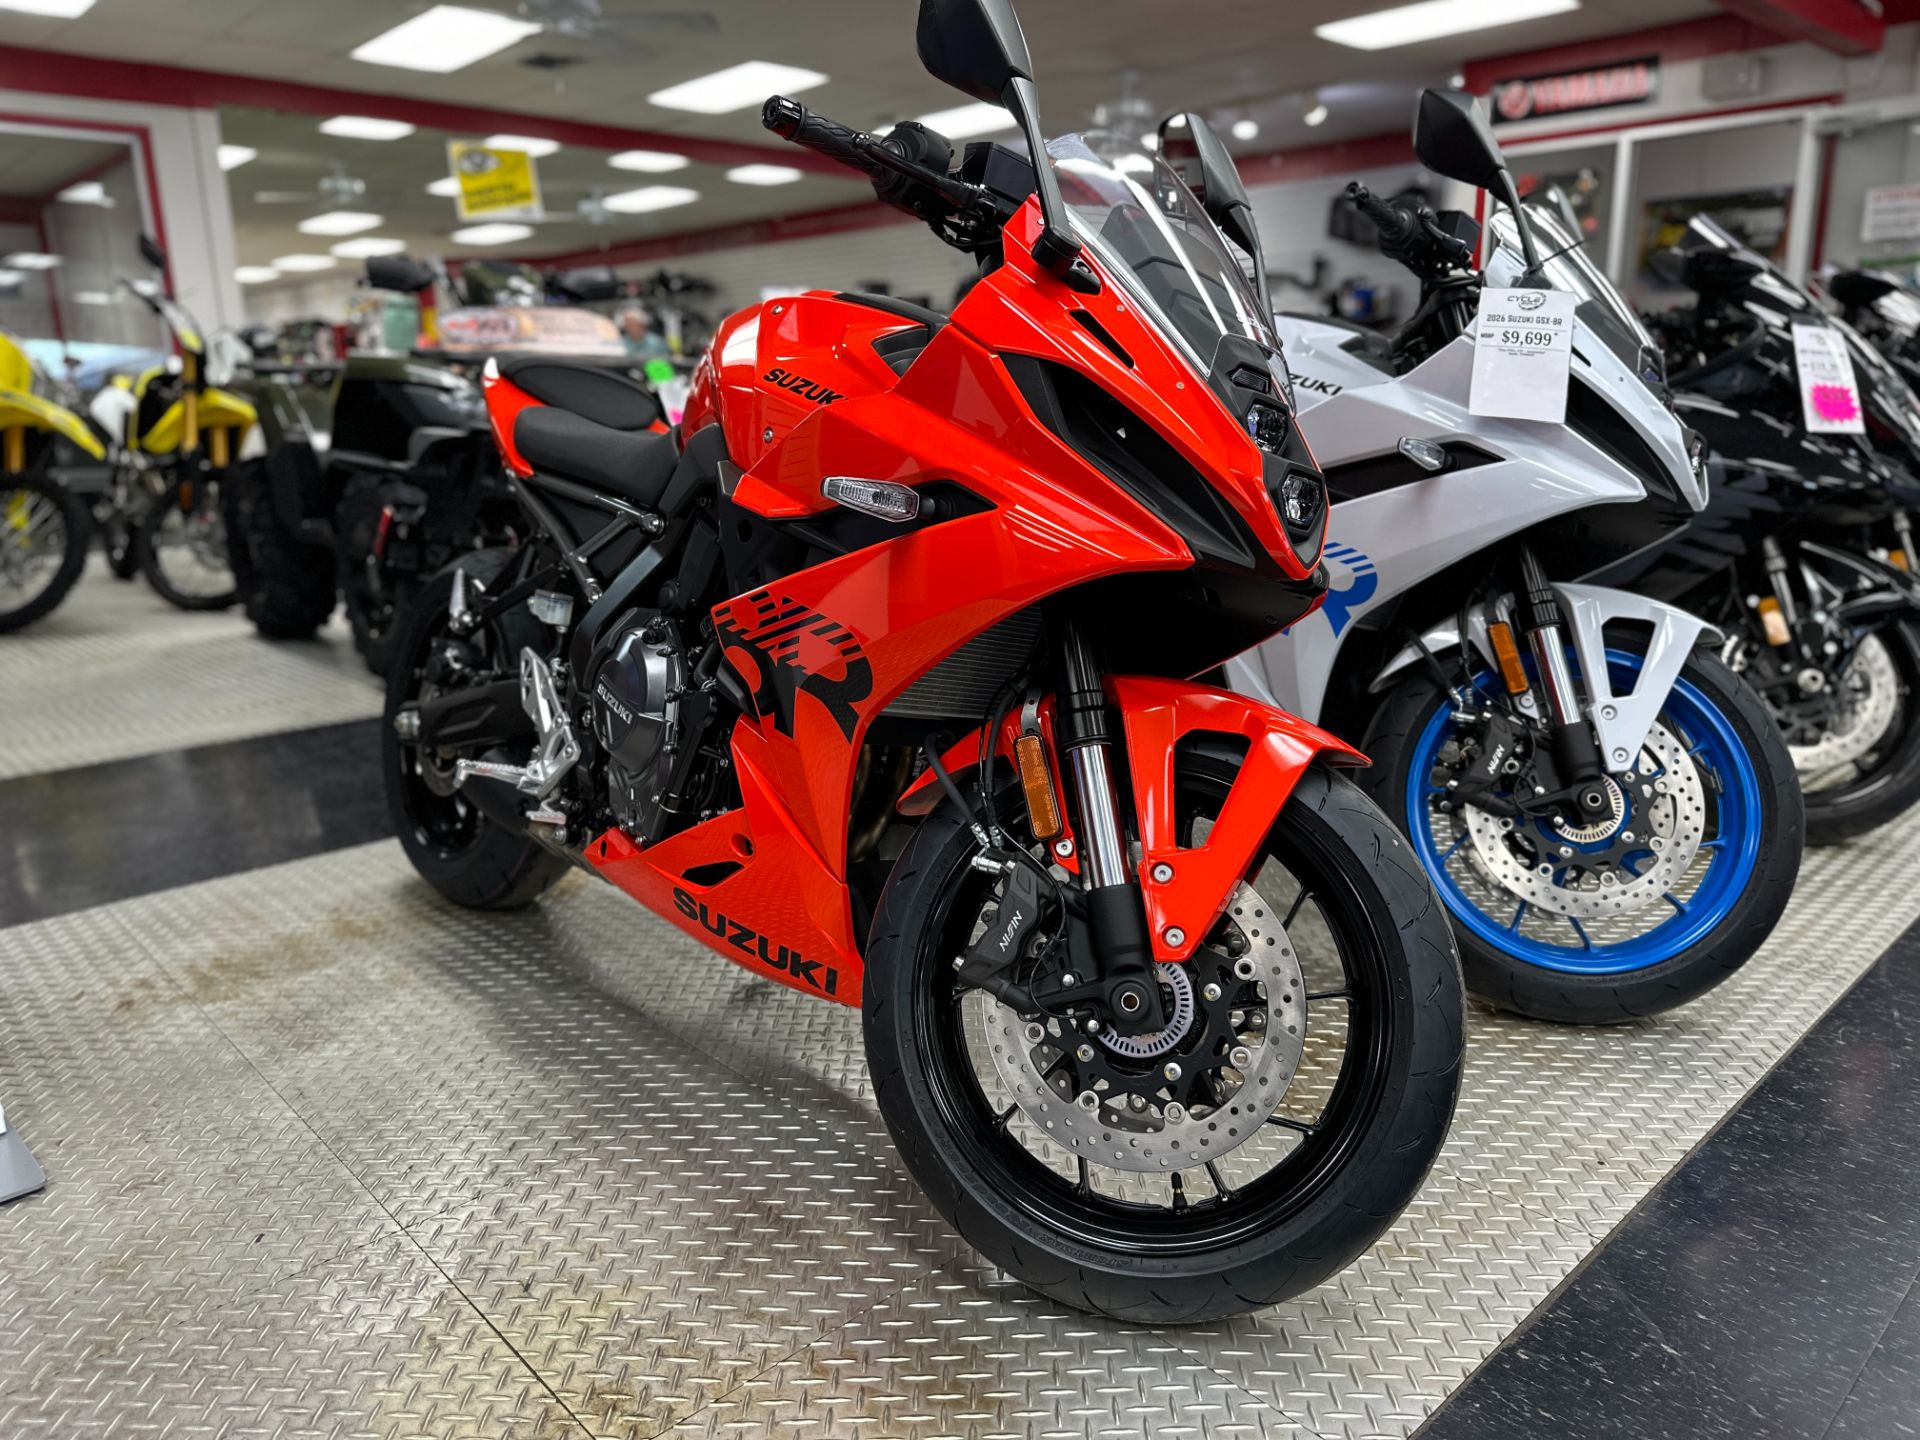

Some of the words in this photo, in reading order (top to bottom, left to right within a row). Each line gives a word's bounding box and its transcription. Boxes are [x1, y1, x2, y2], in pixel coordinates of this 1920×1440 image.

[1486, 313, 1506, 322] 2026
[1507, 314, 1534, 324] SUZUKI
[763, 368, 848, 405] SUZUK
[597, 683, 633, 724] SUZUKI
[673, 887, 838, 996] SUZUKI
